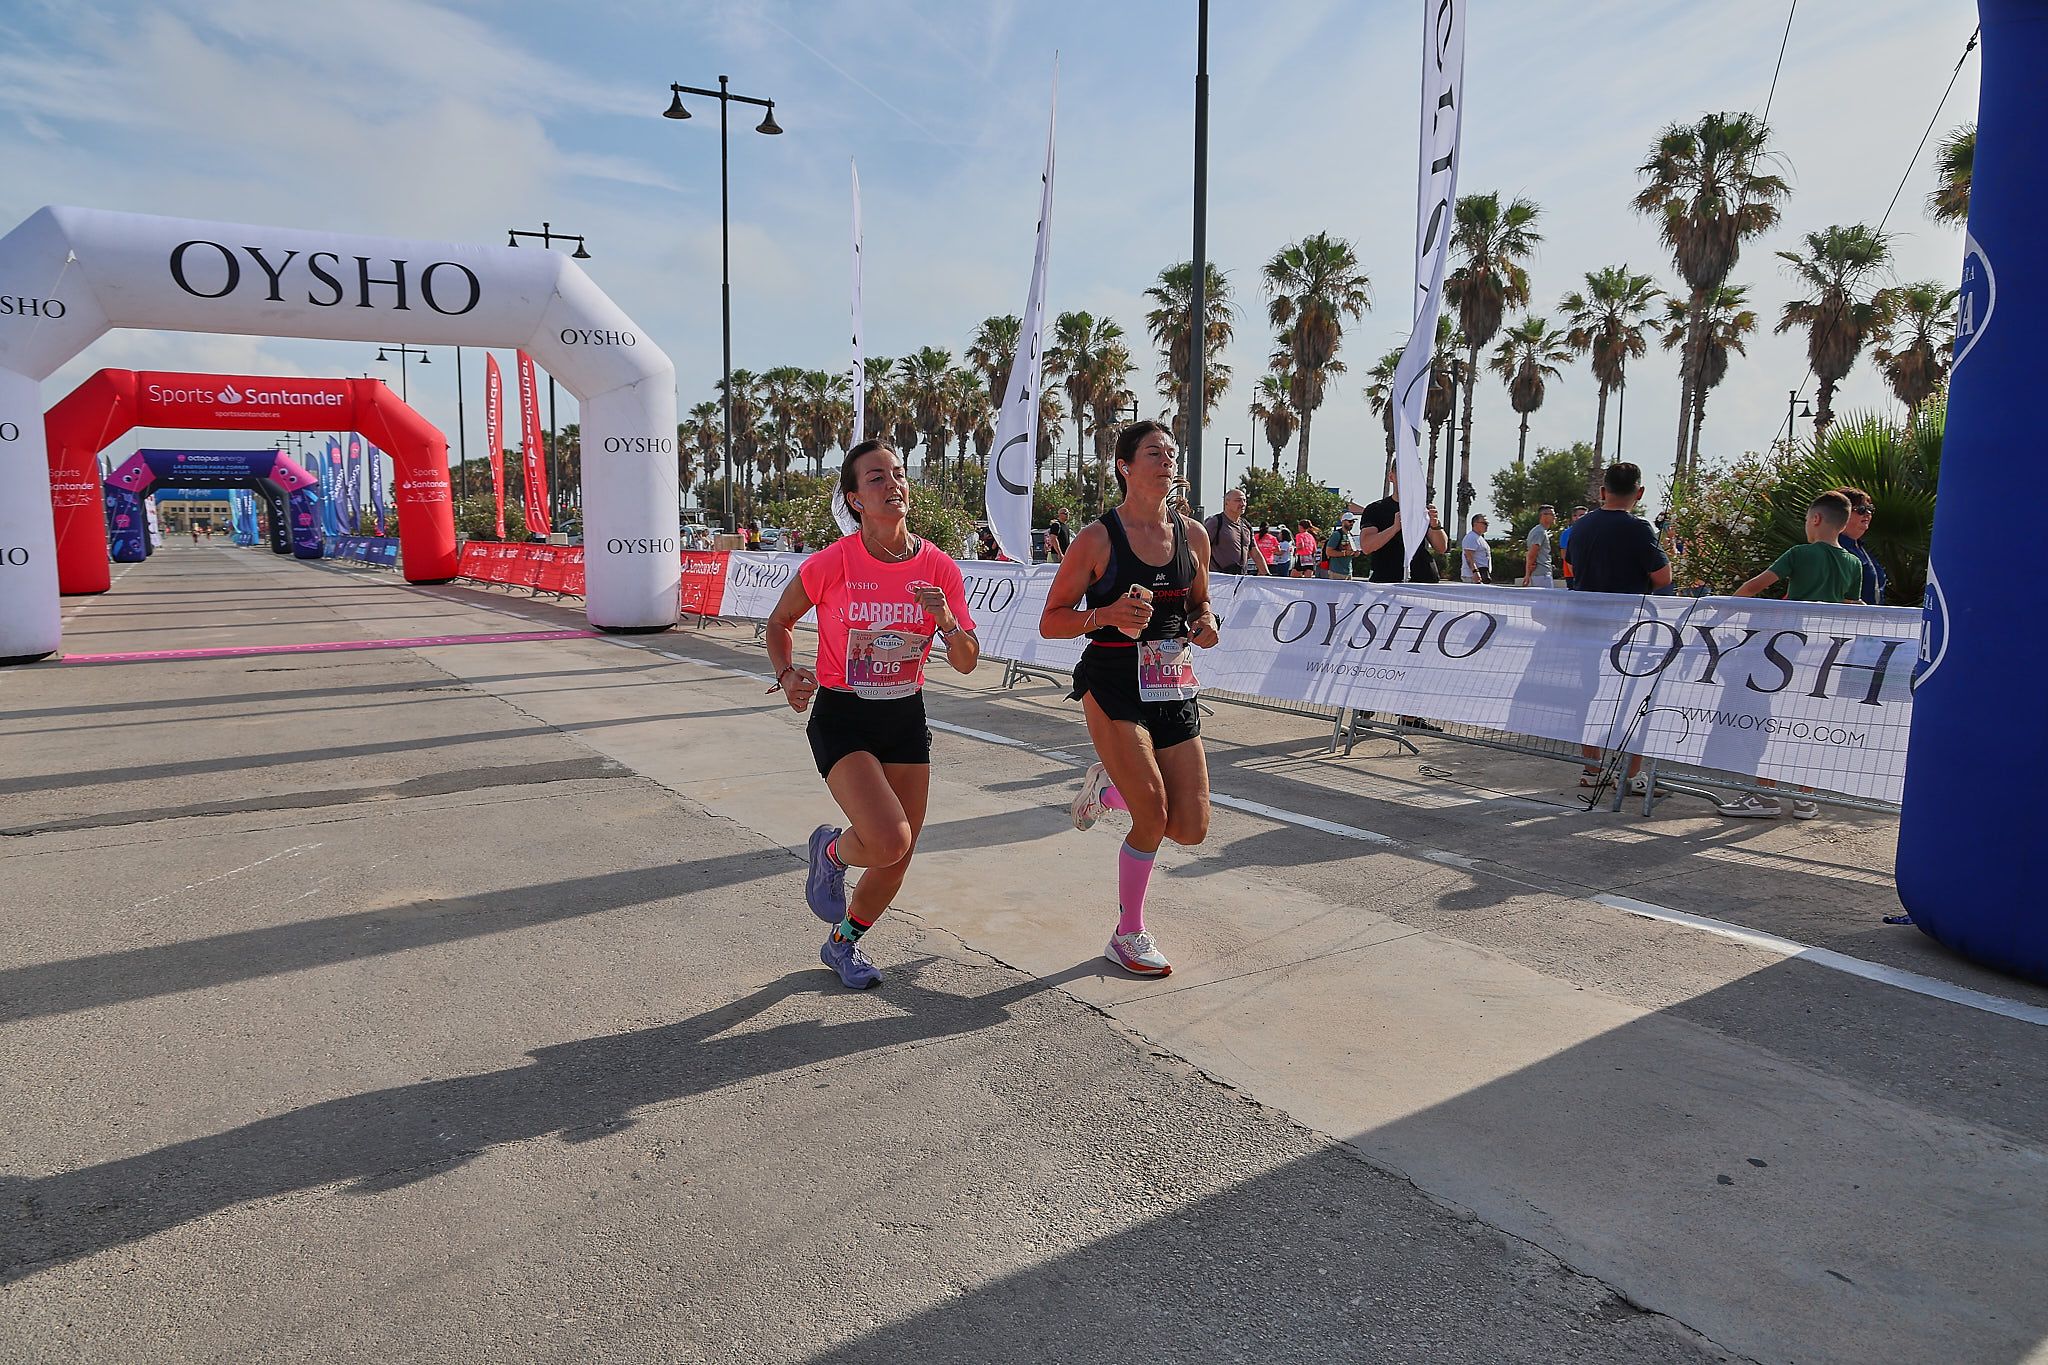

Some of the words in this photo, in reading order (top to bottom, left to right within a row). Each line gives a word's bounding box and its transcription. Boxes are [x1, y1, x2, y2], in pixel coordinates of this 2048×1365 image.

[169, 239, 481, 315] OYSHO
[560, 328, 636, 346] OYSHO
[149, 384, 214, 406] Sports
[245, 388, 344, 406] Santander
[604, 437, 672, 454] OYSHO
[275, 499, 287, 548] VOLVO
[607, 537, 674, 554] OYSHO
[846, 581, 879, 590] OYSHO
[848, 601, 924, 624] CARRERA
[1272, 599, 1498, 659] OYSHO
[873, 661, 901, 674] 016
[1162, 664, 1183, 676] 016
[1305, 660, 1406, 682] WWW.OYSHO.COM
[1609, 620, 1915, 707] OYSH
[1681, 706, 1866, 748] WWW.OYSHO.COM
